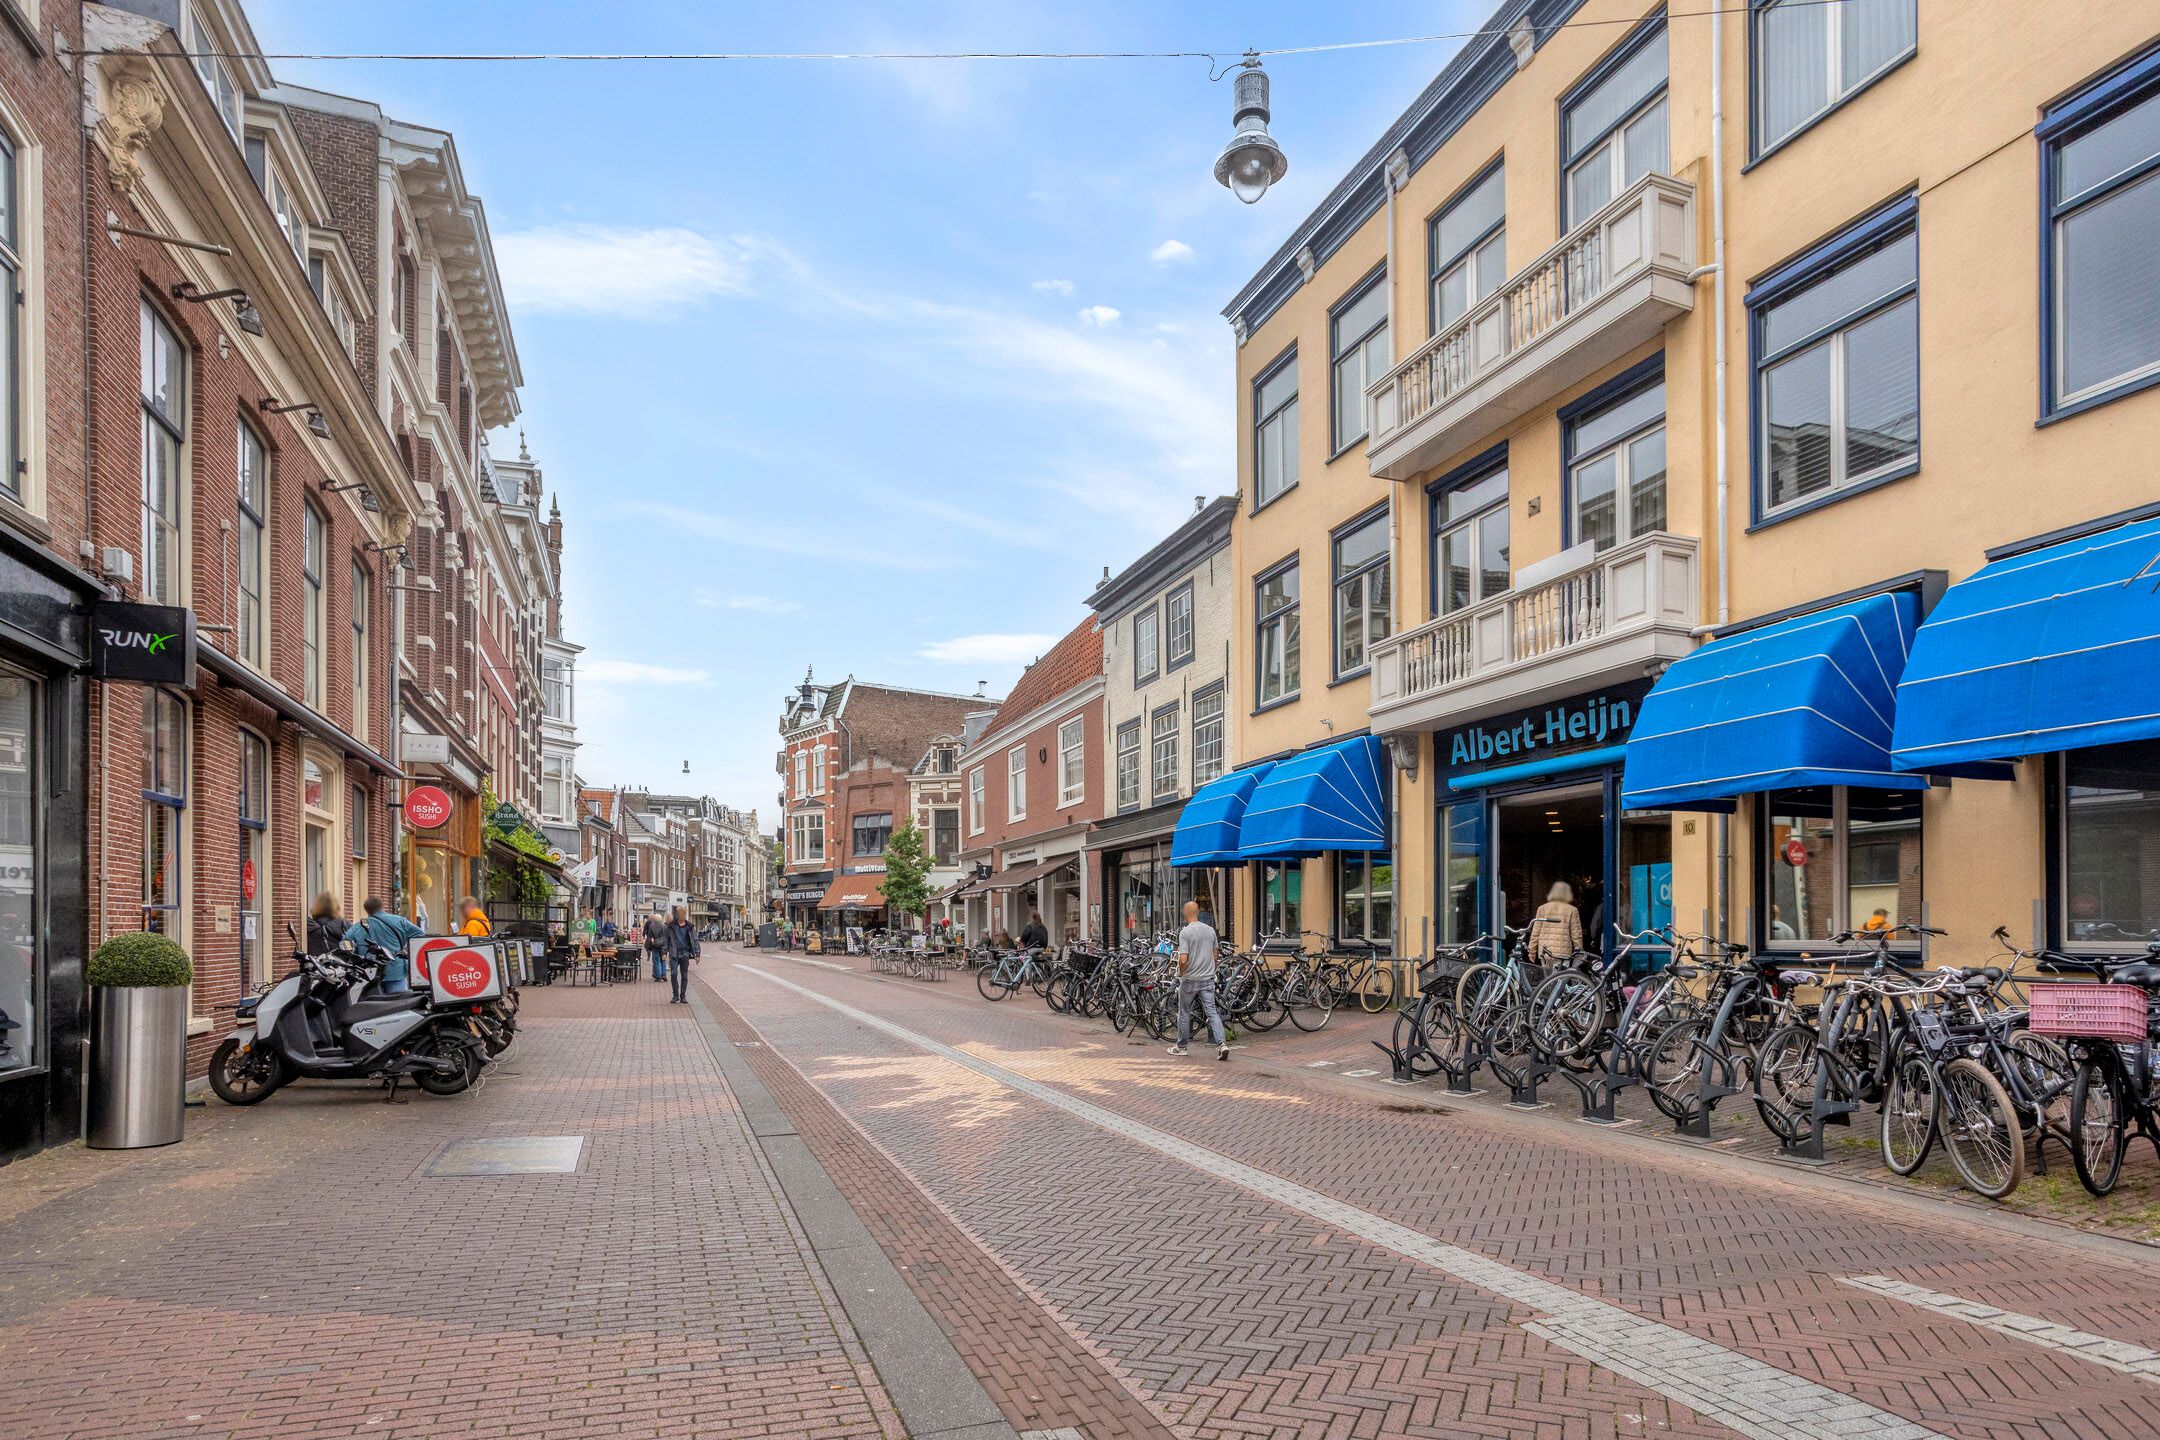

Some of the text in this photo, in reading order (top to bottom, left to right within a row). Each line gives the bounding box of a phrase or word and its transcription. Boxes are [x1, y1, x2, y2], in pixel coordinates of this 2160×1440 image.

[99, 628, 180, 655] RUNX
[1451, 697, 1631, 766] Albert Heijn
[412, 805, 443, 815] ISSHO
[495, 810, 519, 819] Brand
[1684, 822, 1694, 833] 10
[447, 971, 482, 983] ISSHO
[455, 981, 477, 990] SUSHI
